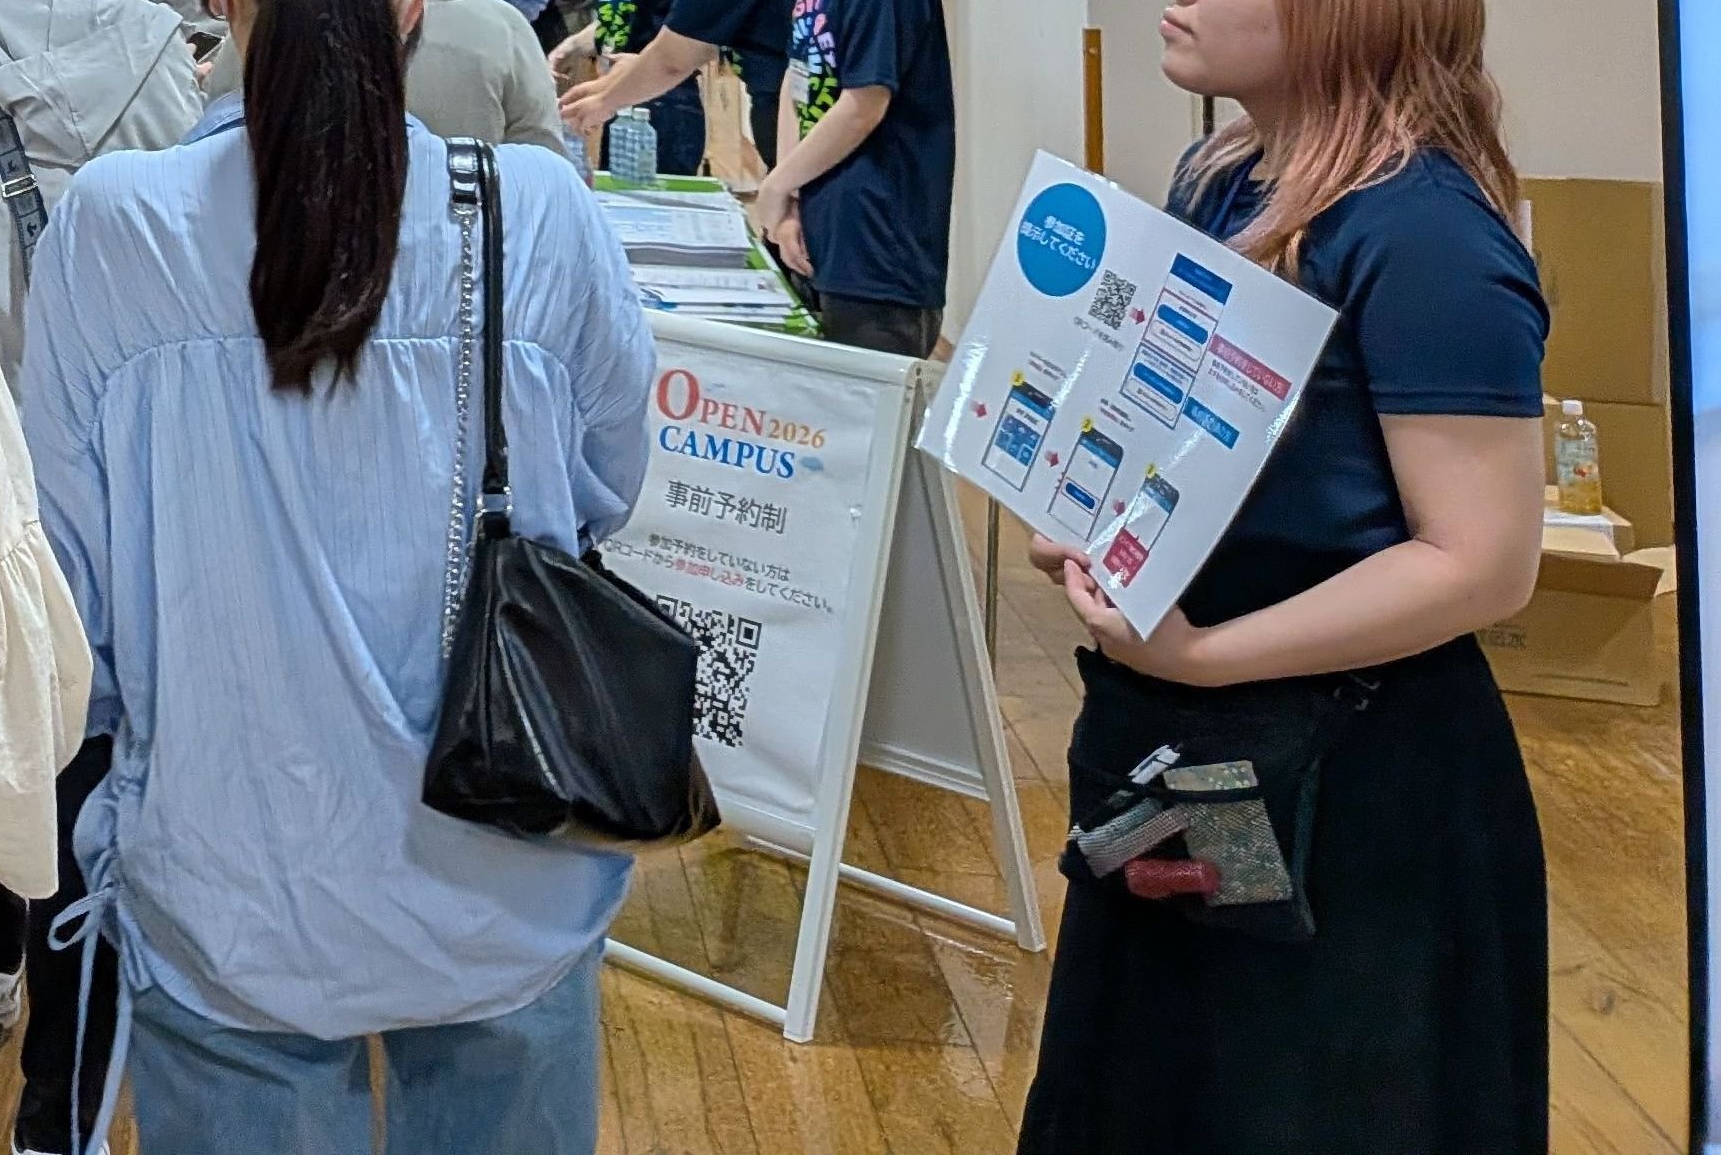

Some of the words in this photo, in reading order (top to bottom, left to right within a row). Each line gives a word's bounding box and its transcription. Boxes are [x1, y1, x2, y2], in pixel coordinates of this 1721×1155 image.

[657, 368, 767, 437] OPEN
[767, 417, 827, 450] 2026
[659, 424, 796, 480] CAMPUS
[665, 479, 788, 535] 事前予約制
[647, 532, 791, 583] 参加予約をしていない方は
